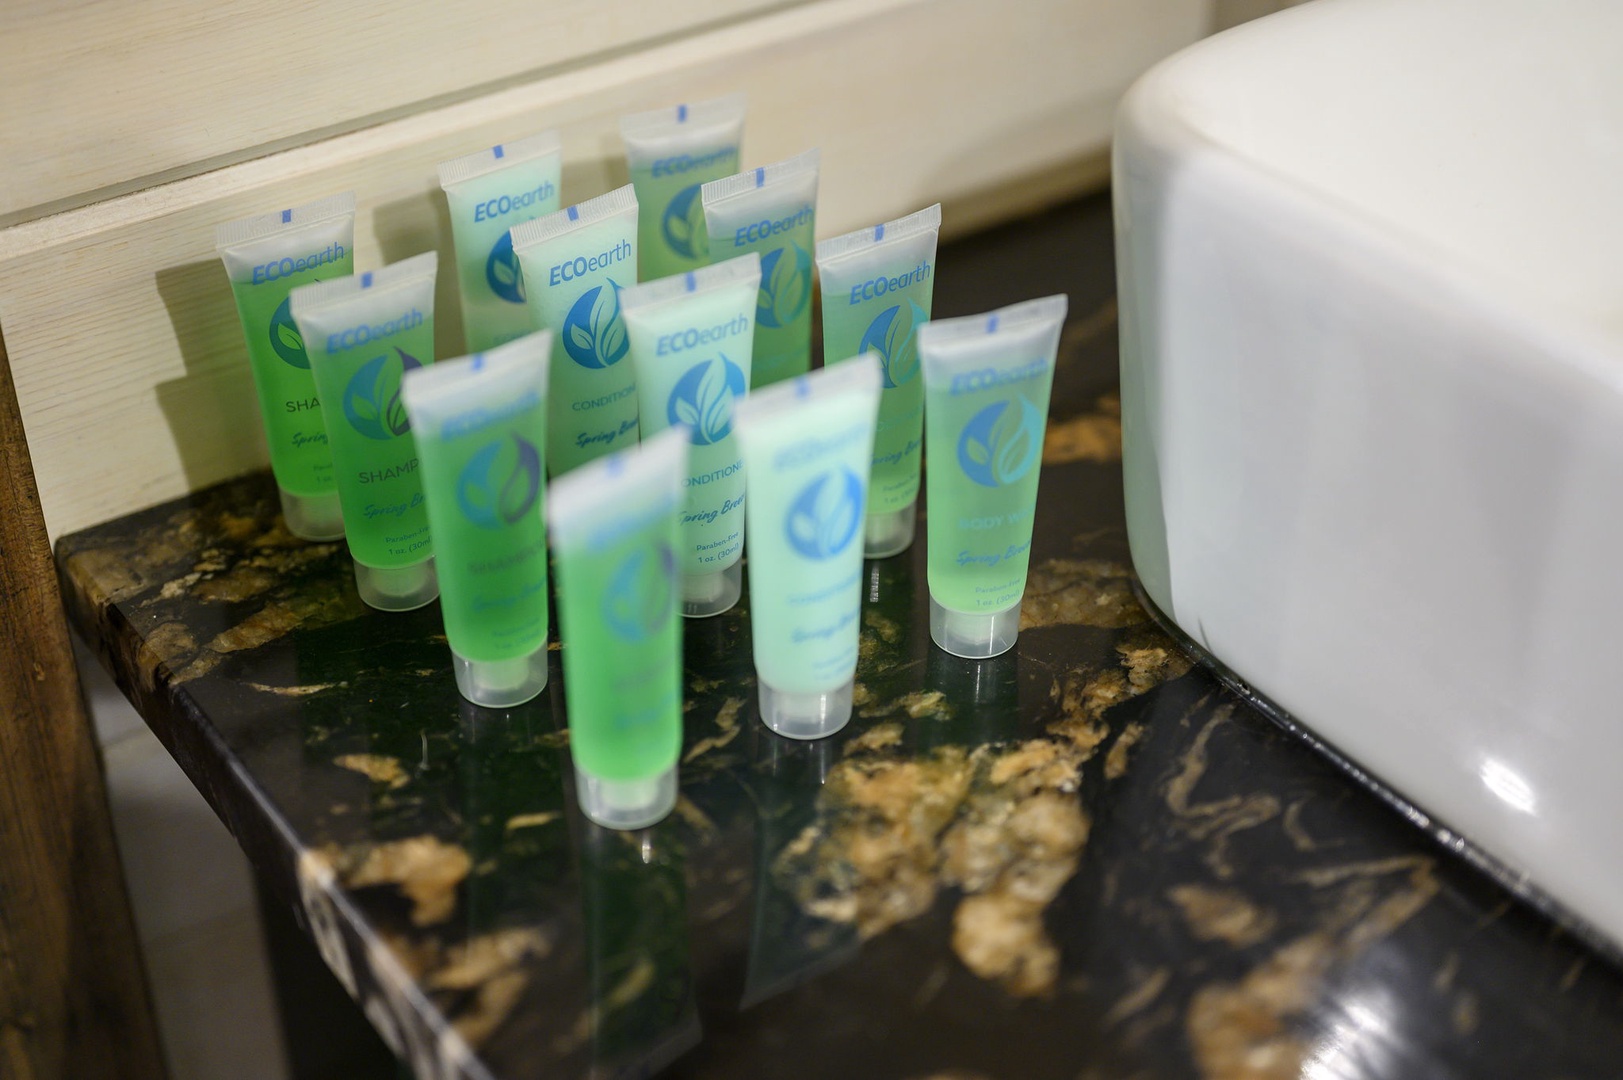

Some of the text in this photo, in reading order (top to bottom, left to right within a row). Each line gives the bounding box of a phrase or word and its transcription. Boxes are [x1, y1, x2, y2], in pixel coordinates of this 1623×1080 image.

[474, 180, 555, 223] ECOearth
[735, 204, 814, 247] ECOearth
[252, 242, 345, 285] ECOearth
[549, 239, 632, 286] ECOearth
[850, 261, 931, 305] ECOearth
[326, 308, 423, 354] ECOearth
[656, 313, 748, 356] ECOearth
[285, 397, 321, 413] SHA
[571, 381, 636, 412] CONDITION
[575, 430, 616, 449] Spring
[358, 458, 419, 484] SHAMP
[363, 503, 407, 520] Spring
